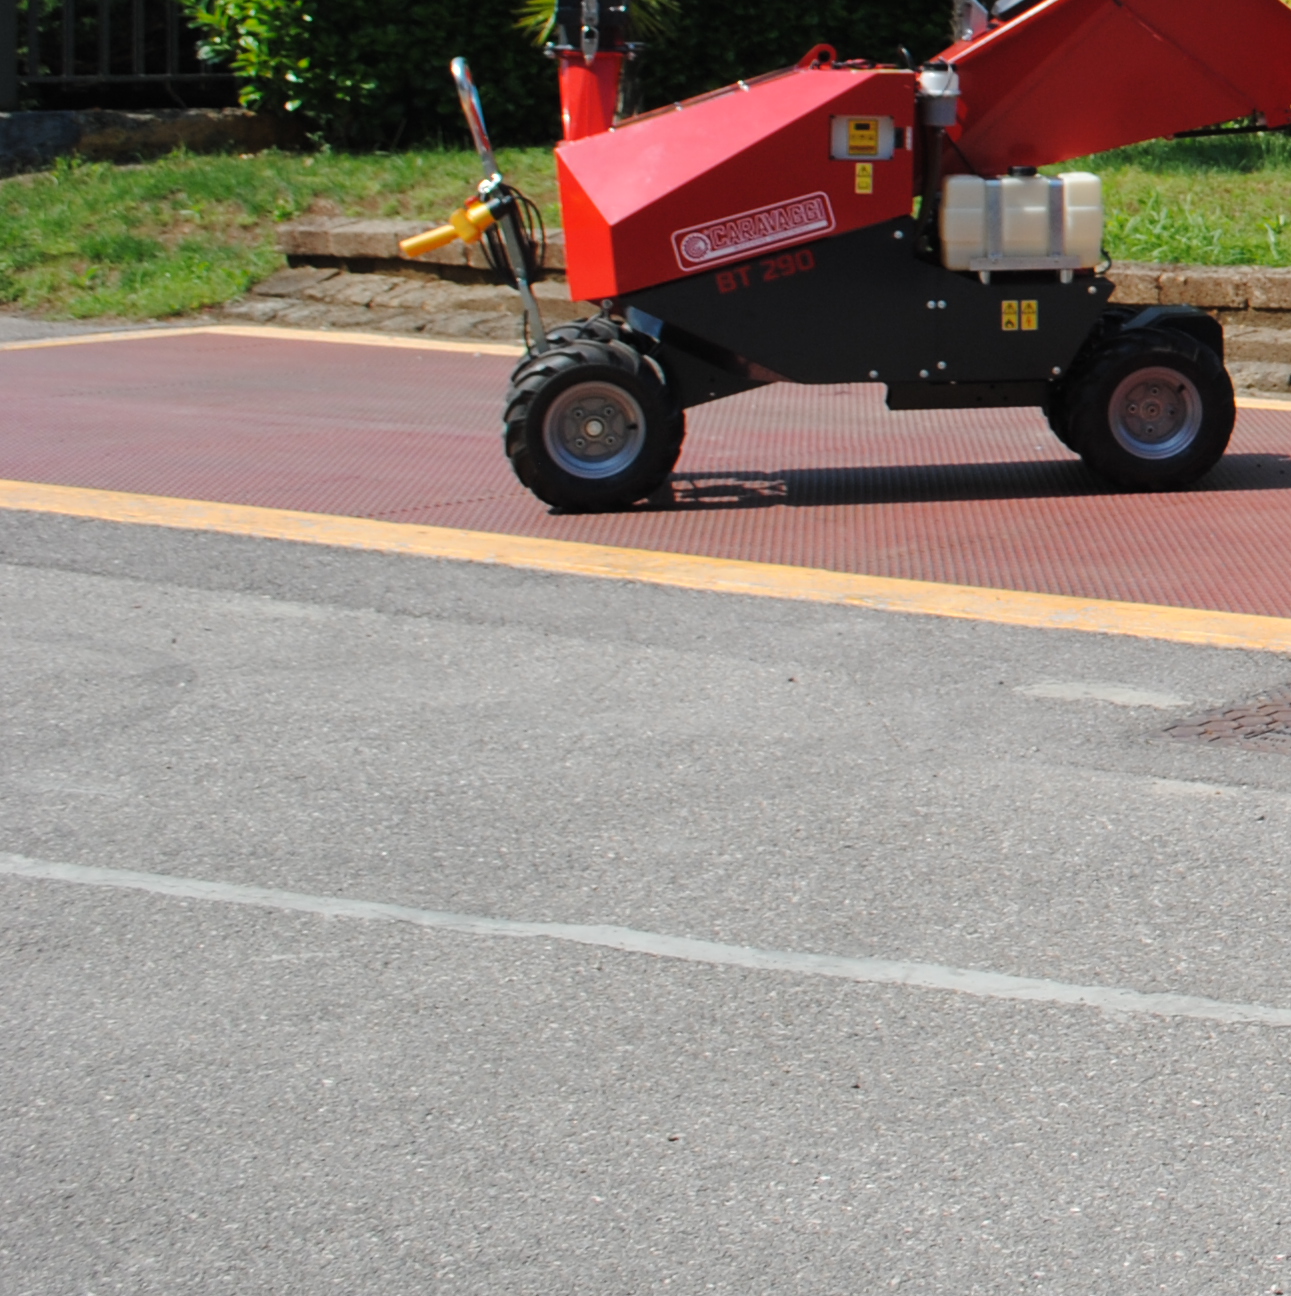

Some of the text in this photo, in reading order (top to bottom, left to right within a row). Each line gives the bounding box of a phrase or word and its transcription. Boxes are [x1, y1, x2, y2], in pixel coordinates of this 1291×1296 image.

[709, 197, 828, 250] CARAVAGGI
[715, 249, 816, 294] BT 290
